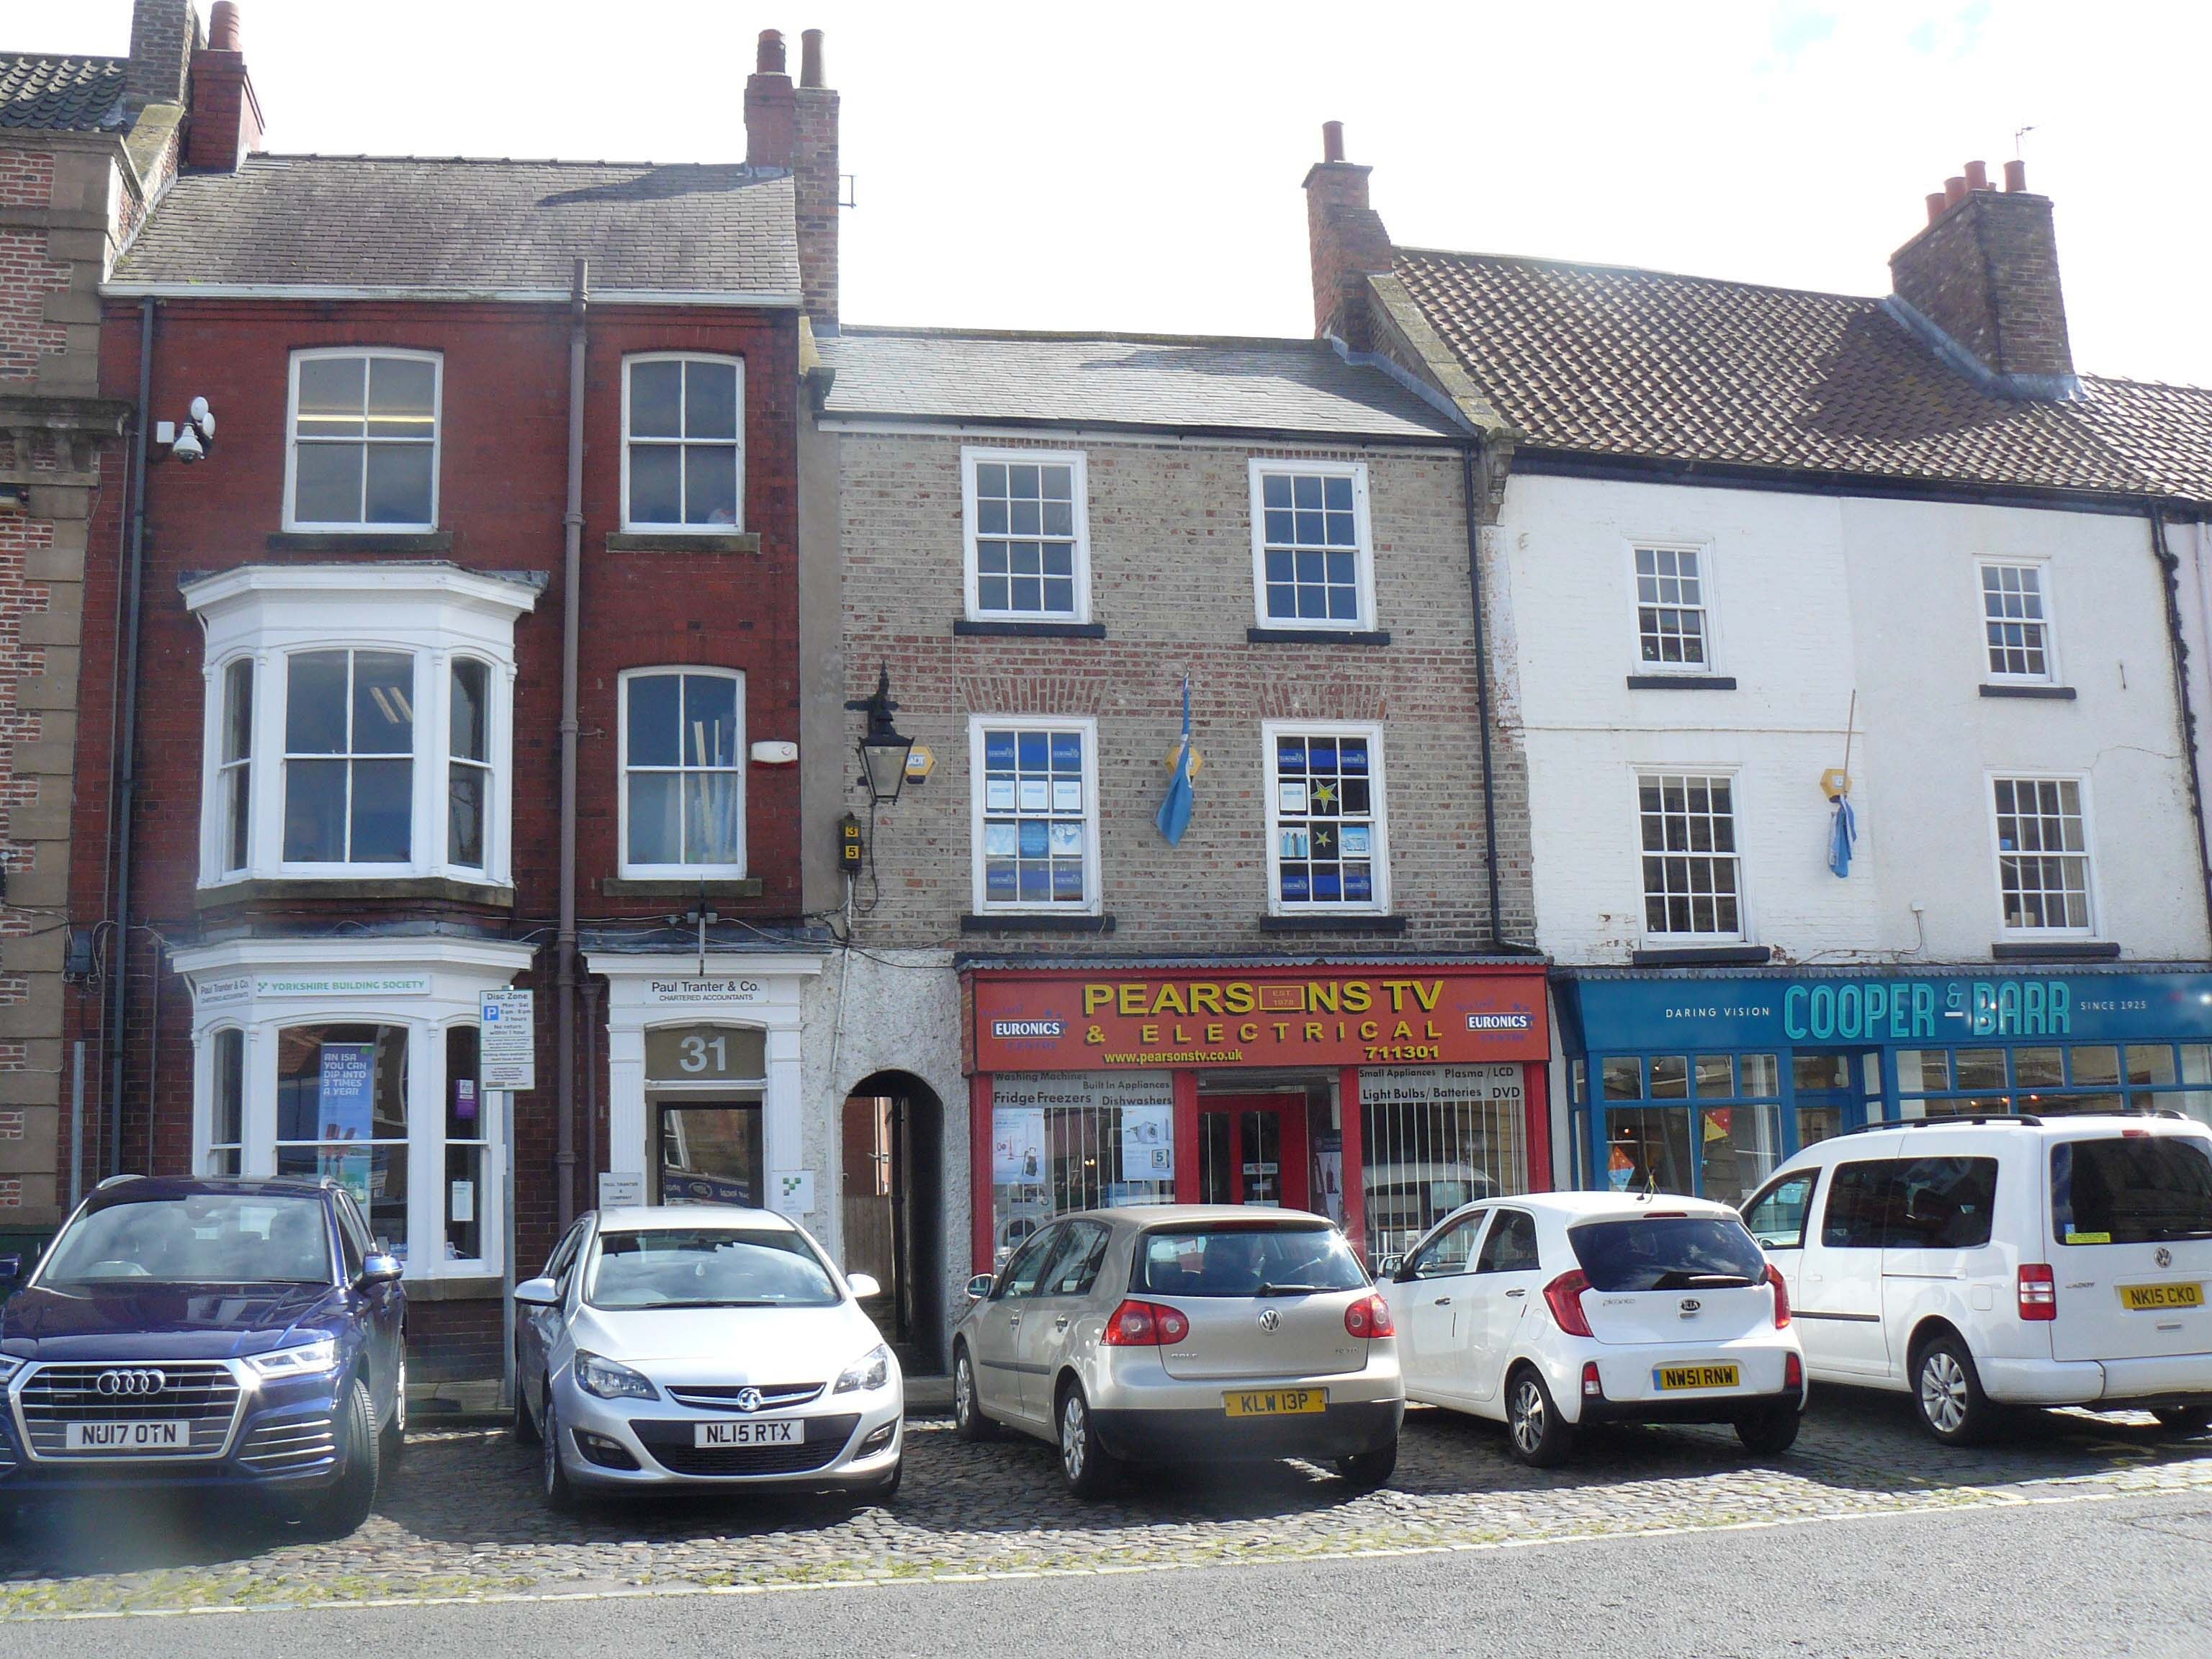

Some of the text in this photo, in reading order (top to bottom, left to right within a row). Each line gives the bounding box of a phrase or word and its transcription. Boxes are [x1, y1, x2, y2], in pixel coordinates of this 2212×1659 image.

[848, 826, 855, 837] 3
[848, 847, 856, 858] 5
[271, 980, 425, 991] YORKSHIRE BUILDING SOCIETY
[652, 981, 760, 992] Paul Tranter & Co.
[1382, 980, 1444, 1011] TV
[1784, 980, 2071, 1039] COOPER & BARR
[2080, 1000, 2147, 1010] SINCE 1925
[487, 1007, 497, 1020] P
[1665, 1007, 1770, 1018] DARING VISION
[1468, 1015, 1527, 1028] EURONICS
[995, 1022, 1061, 1035] EURONICS
[1085, 1020, 1442, 1043] & ELECTRICAL
[680, 1035, 727, 1072] 31
[1104, 1049, 1243, 1065] www.pearsonstv.co.uk
[1364, 1045, 1439, 1059] 711301
[995, 1071, 1087, 1082] Washing Machines
[1359, 1068, 1436, 1079] Small Appliances
[1444, 1069, 1483, 1079] Plasma
[1493, 1067, 1514, 1077] LCD
[333, 1079, 362, 1087] TIMES
[1083, 1081, 1170, 1091] Built In Appliances
[994, 1092, 1092, 1106] Fridge Freezers
[1363, 1088, 1390, 1102] Light
[1433, 1087, 1482, 1098] Batteries
[1493, 1087, 1521, 1098] DVD
[1102, 1095, 1172, 1106] Dishwashers
[1156, 1152, 1164, 1162] 5
[2130, 1288, 2163, 1305] NK15
[1665, 1367, 1733, 1386] NW51 RNW
[1241, 1393, 1308, 1413] KLW 13P
[82, 1424, 176, 1444] NU17 OTN
[706, 1423, 791, 1443] NL15 RTX
